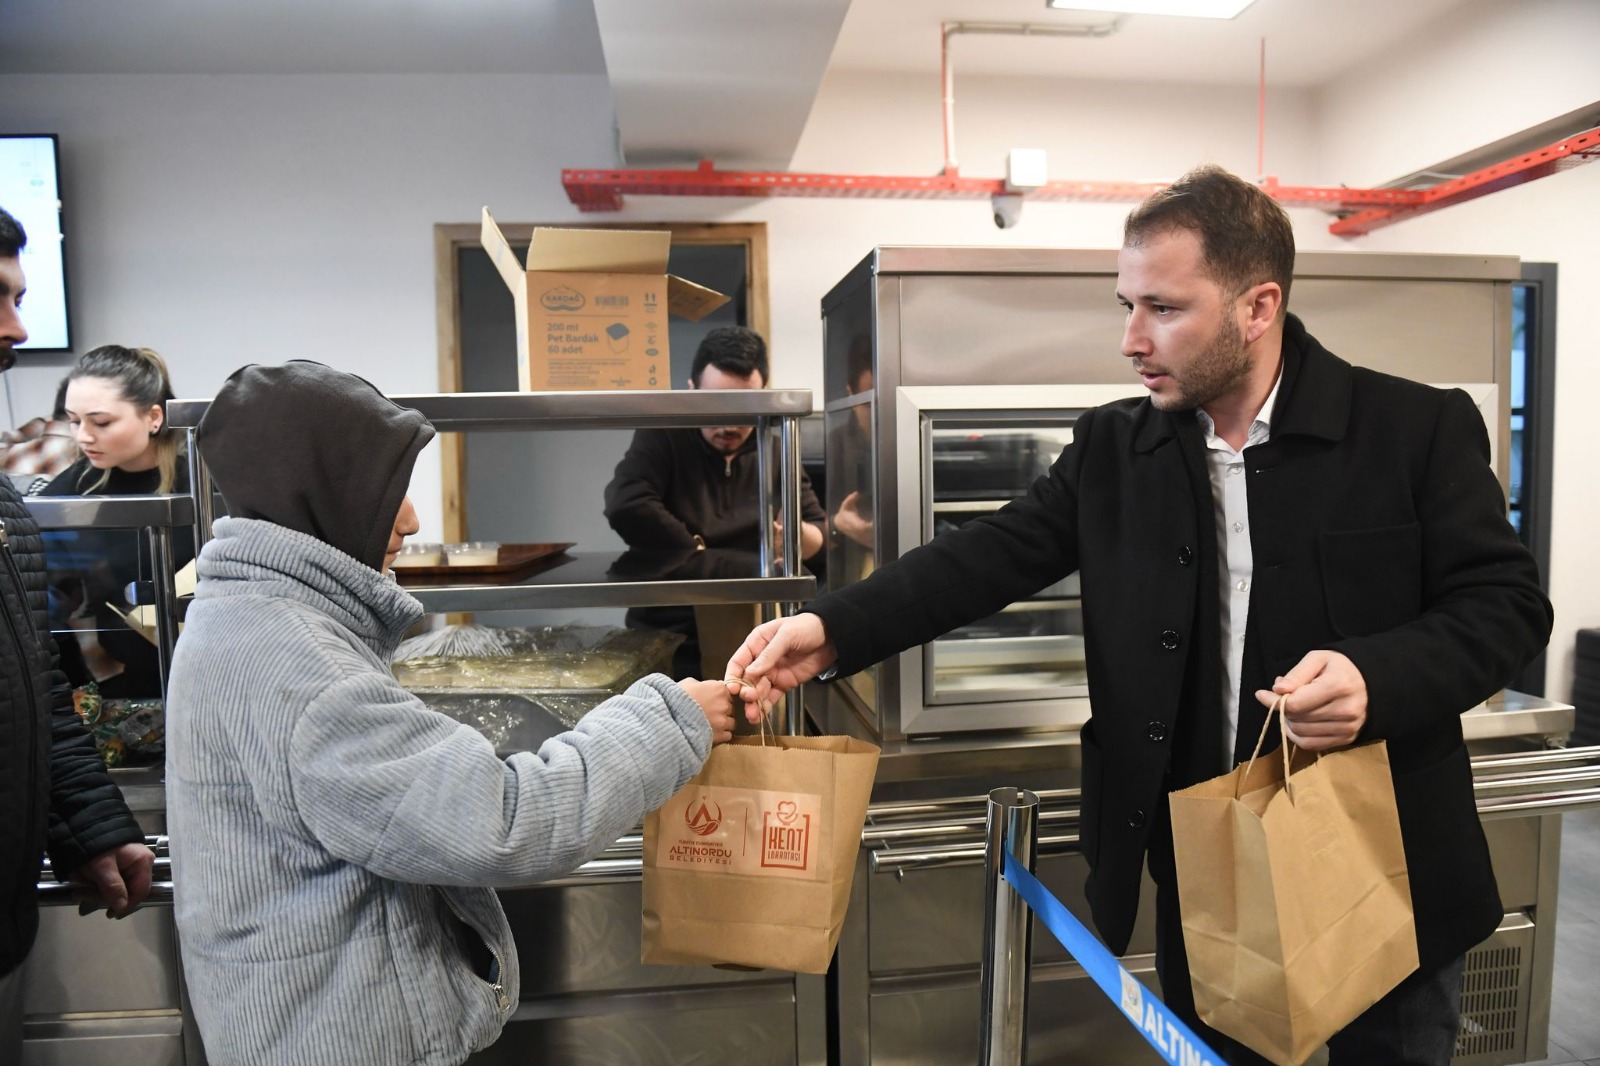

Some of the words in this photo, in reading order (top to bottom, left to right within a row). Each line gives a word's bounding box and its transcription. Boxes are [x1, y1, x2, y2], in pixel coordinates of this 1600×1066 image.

[547, 323, 564, 332] 200
[567, 322, 579, 331] ml
[547, 334, 563, 343] Pet
[566, 334, 599, 343] Bardak
[561, 345, 583, 354] adet
[770, 827, 804, 852] KENT
[669, 846, 732, 858] ALTINORDU
[1145, 1003, 1213, 1066] ALTIN
